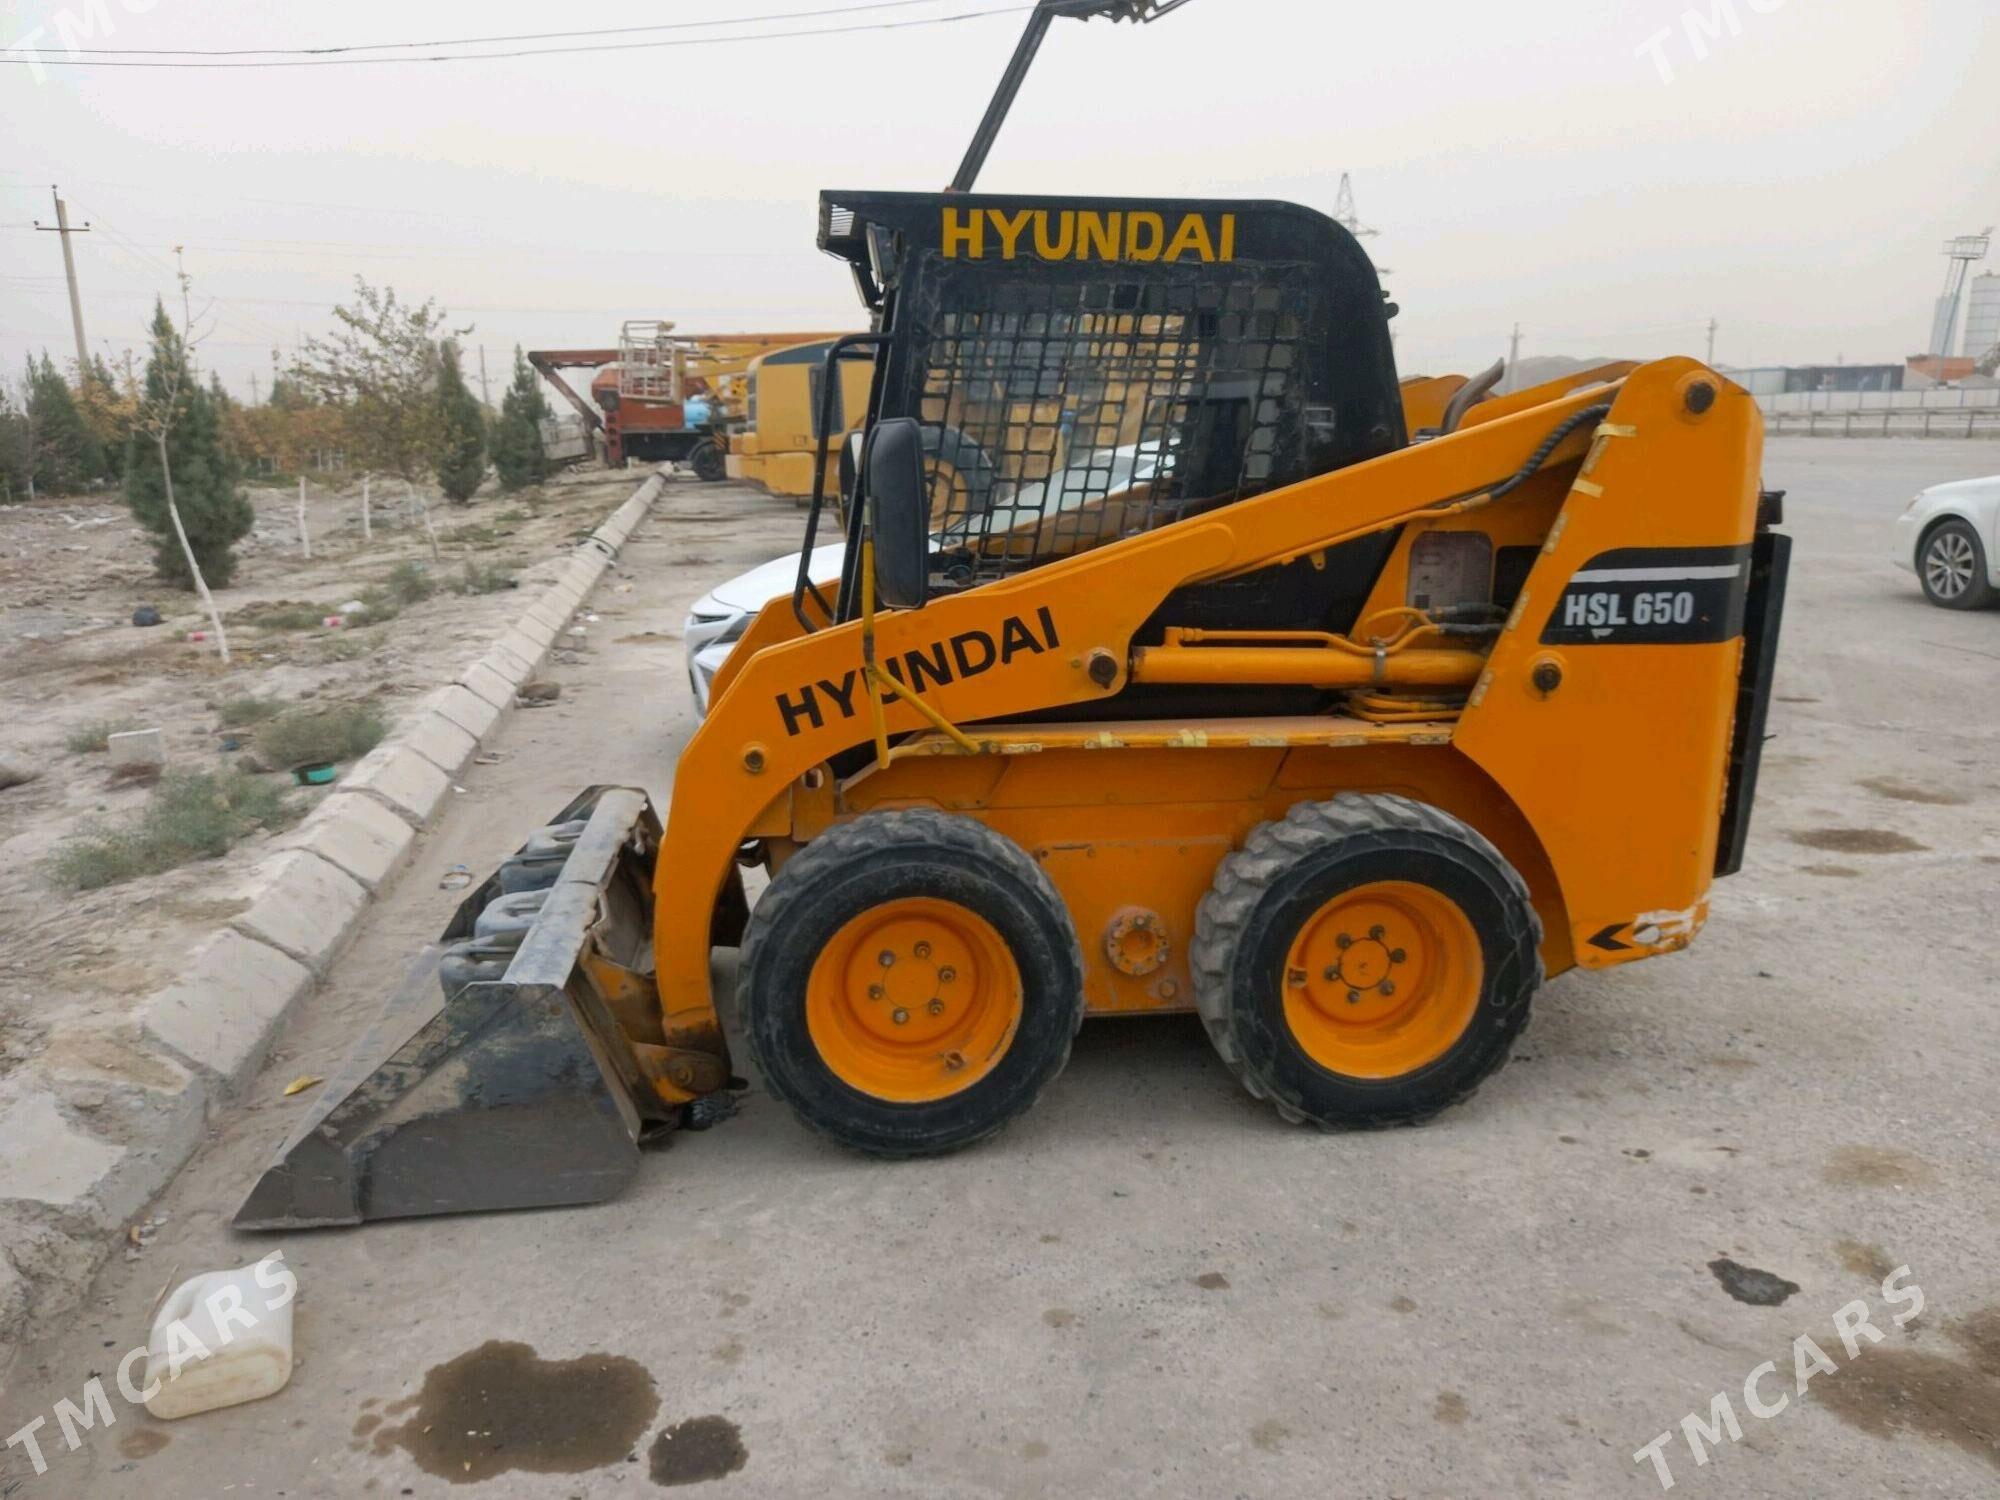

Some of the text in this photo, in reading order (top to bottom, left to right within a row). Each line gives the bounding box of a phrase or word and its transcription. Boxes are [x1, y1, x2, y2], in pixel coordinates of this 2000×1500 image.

[942, 207, 1236, 262] HYUNDAI
[1564, 591, 1694, 626] HSL 650
